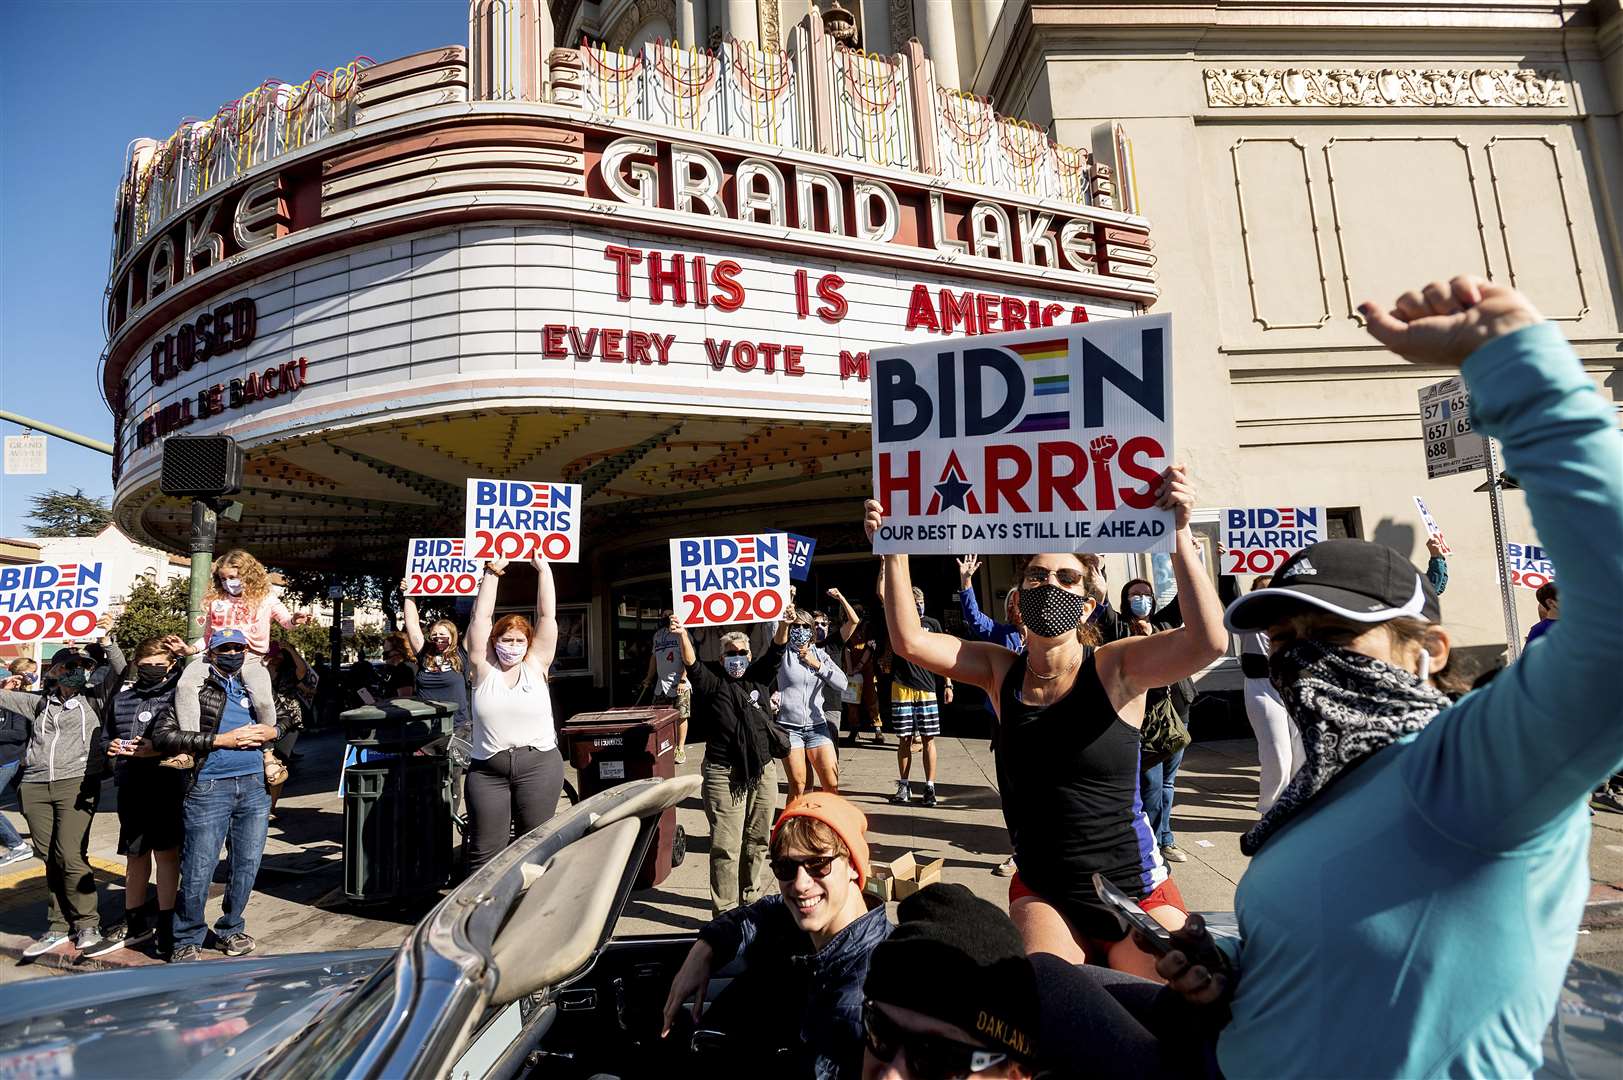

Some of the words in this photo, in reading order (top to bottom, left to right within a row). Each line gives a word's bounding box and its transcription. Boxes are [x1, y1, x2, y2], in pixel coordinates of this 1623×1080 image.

[601, 136, 899, 243] GRAND
[930, 191, 1099, 275] LAKE
[127, 173, 285, 318] LAKE
[604, 245, 746, 312] THIS
[794, 269, 849, 324] IS
[151, 297, 257, 386] CLOSED
[541, 324, 676, 365] EVERY
[705, 338, 805, 376] VOTE
[198, 383, 224, 419] BE
[229, 357, 308, 409] BACK!
[876, 328, 1165, 443] BIDEN
[1425, 404, 1439, 419] 57
[1428, 423, 1448, 440] 657
[1457, 418, 1472, 433] 65
[1427, 442, 1447, 458] 688
[879, 435, 1165, 517] HARRIS
[476, 481, 572, 509] BIDEN
[475, 508, 571, 531] HARRIS
[880, 525, 914, 541] OUR
[919, 524, 957, 540] BEST
[962, 523, 1007, 540] DAYS
[1013, 522, 1060, 538] STILL
[1065, 521, 1092, 537] LIE
[1097, 520, 1165, 537] AHEAD
[1228, 507, 1318, 529] BIDEN
[414, 540, 466, 557] BIDE
[474, 531, 571, 560] 2020
[680, 536, 779, 567] BIDEN
[1228, 530, 1318, 548] HARRIS
[411, 558, 477, 573] HARRIS
[1229, 549, 1290, 574] 202
[0, 562, 102, 591] BIDEN
[409, 574, 476, 594] 2020
[681, 564, 781, 592] HARRIS
[0, 588, 98, 612] HARRIS
[683, 589, 783, 625] 2020
[0, 610, 97, 641] 2020
[666, 651, 675, 664] 4
